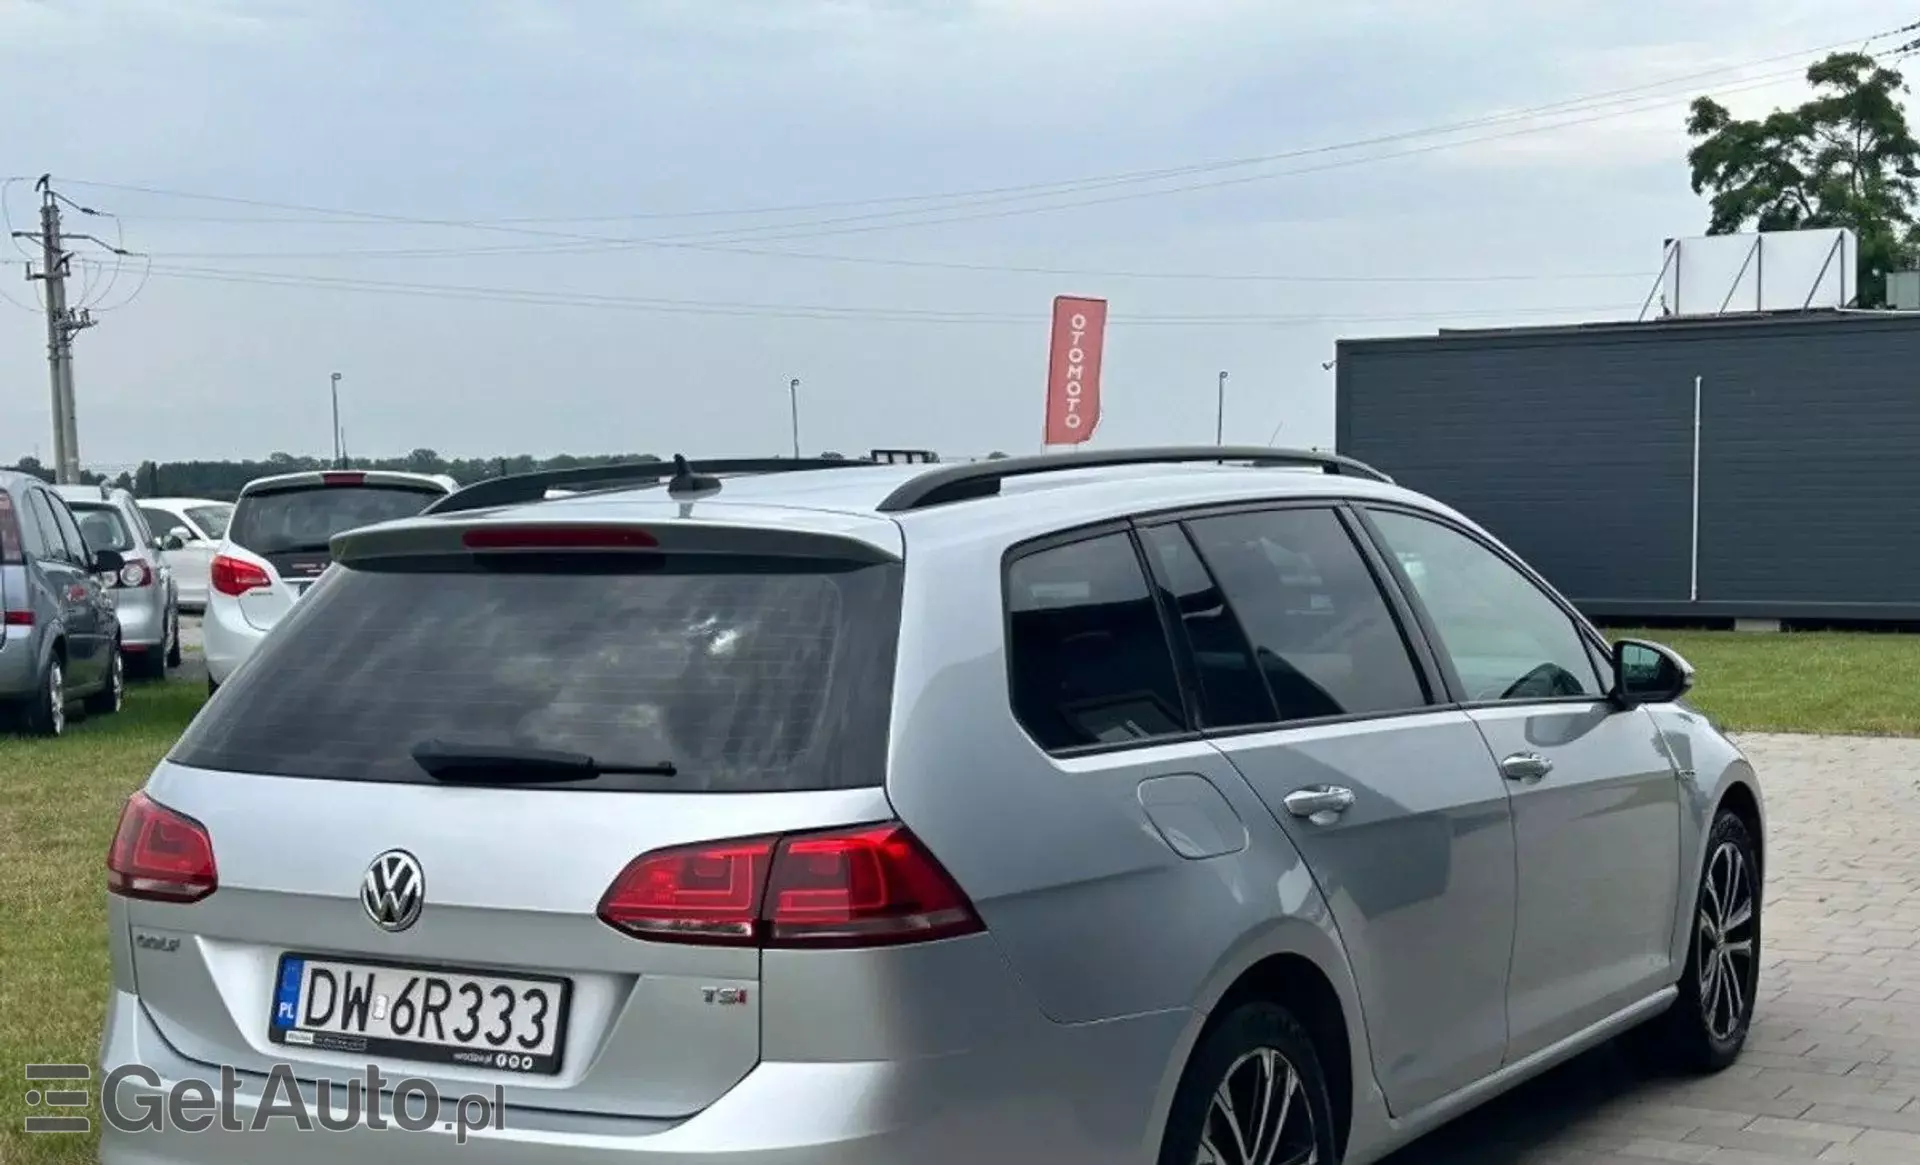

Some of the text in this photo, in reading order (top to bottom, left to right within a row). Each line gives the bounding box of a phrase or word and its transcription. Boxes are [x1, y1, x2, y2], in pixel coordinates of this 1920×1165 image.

[1064, 313, 1086, 428] OTOMOTO
[278, 1002, 294, 1018] PL
[303, 968, 549, 1049] DW 6R333
